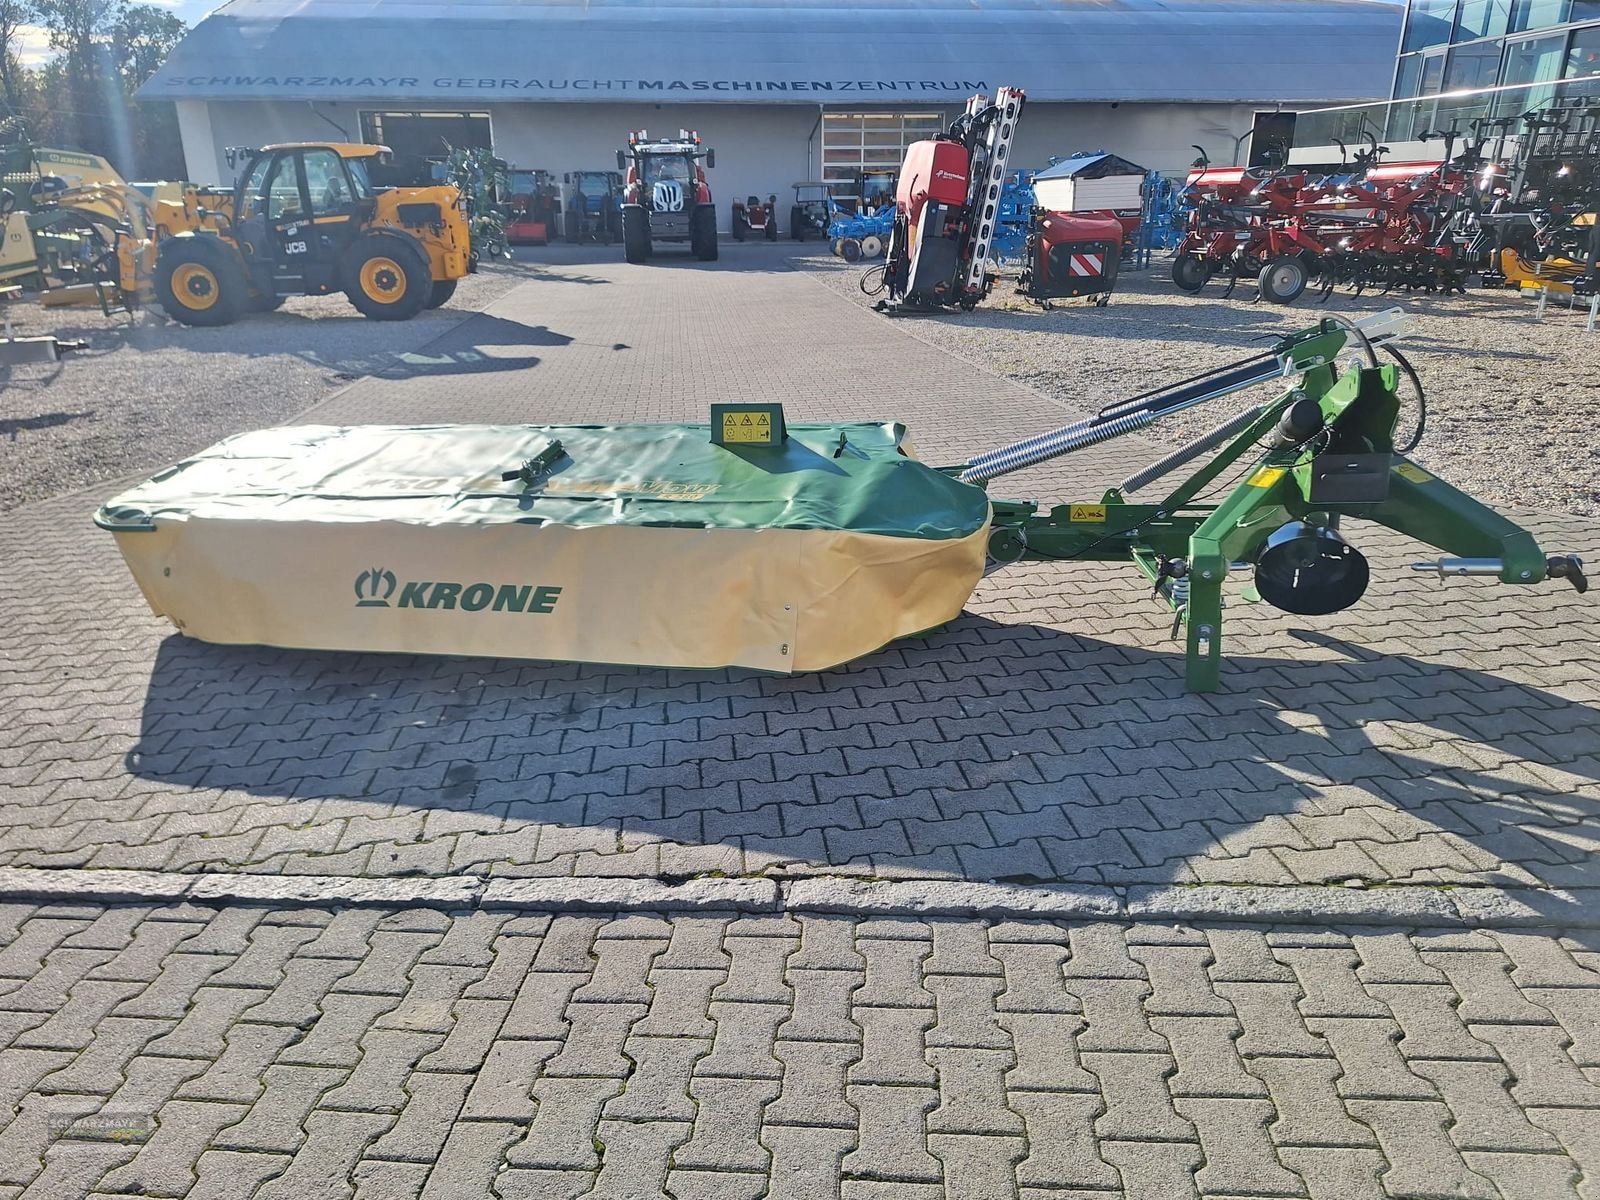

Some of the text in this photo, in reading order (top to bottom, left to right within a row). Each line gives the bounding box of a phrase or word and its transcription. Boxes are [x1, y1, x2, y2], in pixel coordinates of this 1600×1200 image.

[165, 76, 988, 91] SCHWARZMAYR GEBRAUCHTMASCHINENZENTRUM
[285, 241, 307, 254] JCB
[397, 581, 563, 614] KRONE
